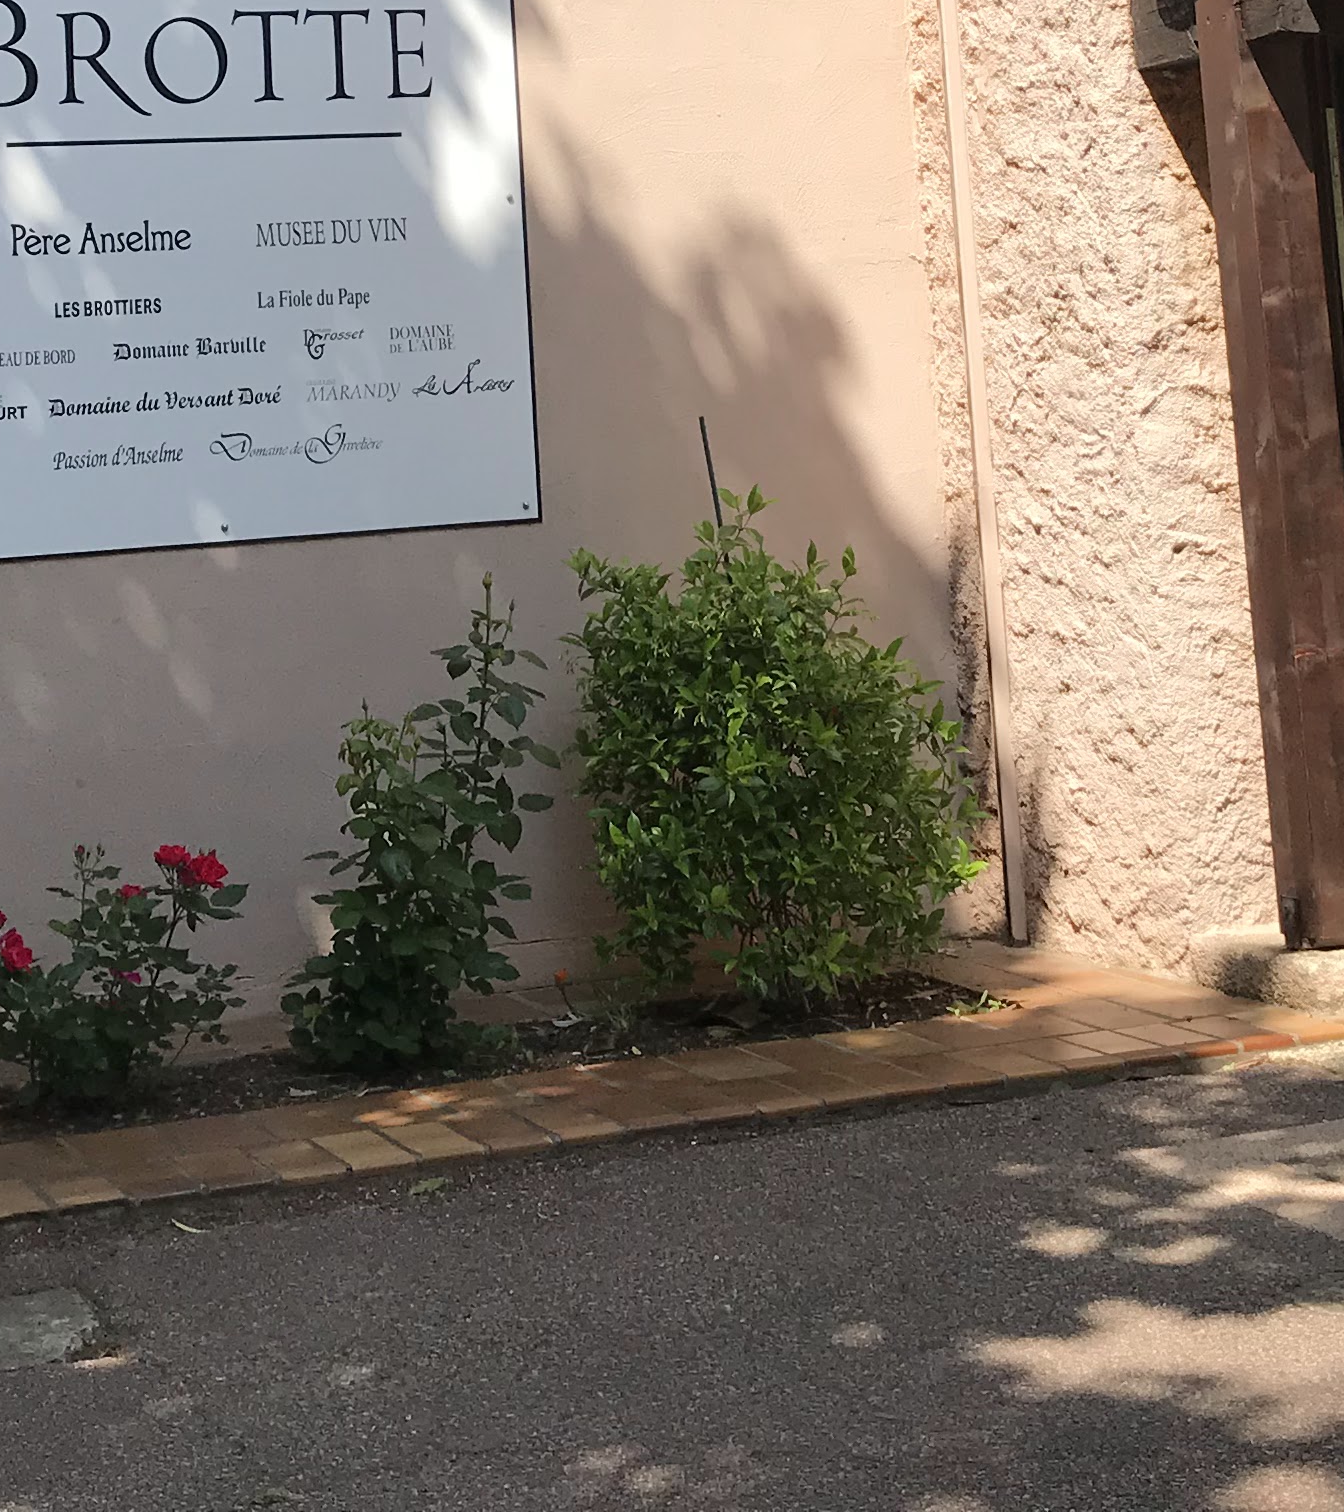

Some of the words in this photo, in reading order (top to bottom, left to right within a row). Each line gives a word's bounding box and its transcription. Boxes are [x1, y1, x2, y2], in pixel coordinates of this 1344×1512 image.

[10, 223, 71, 256] Père
[78, 220, 192, 255] Anselme
[256, 222, 325, 248] MUSEE
[331, 219, 362, 244] DU
[368, 217, 407, 243] VIN
[55, 302, 80, 318] LES
[84, 297, 162, 317] BROTTIERS
[258, 291, 275, 308] La
[279, 289, 313, 307] Fiole
[316, 289, 335, 306] du
[338, 288, 370, 309] Pape
[390, 325, 454, 340] DOMAINE
[113, 341, 190, 361] Domaine
[195, 336, 267, 358] Barville
[390, 344, 403, 354] DE
[409, 338, 455, 352] L'AUBE
[25, 350, 43, 367] DE
[44, 349, 76, 366] BORD
[49, 397, 131, 418] Domaine
[136, 393, 161, 411] du
[165, 391, 233, 409] Versant
[237, 385, 282, 406] Doré
[307, 382, 400, 402] MARANDY
[53, 449, 108, 471] Passion
[111, 442, 184, 466] d'Anselme
[209, 433, 289, 462] Domaine
[290, 442, 303, 455] de
